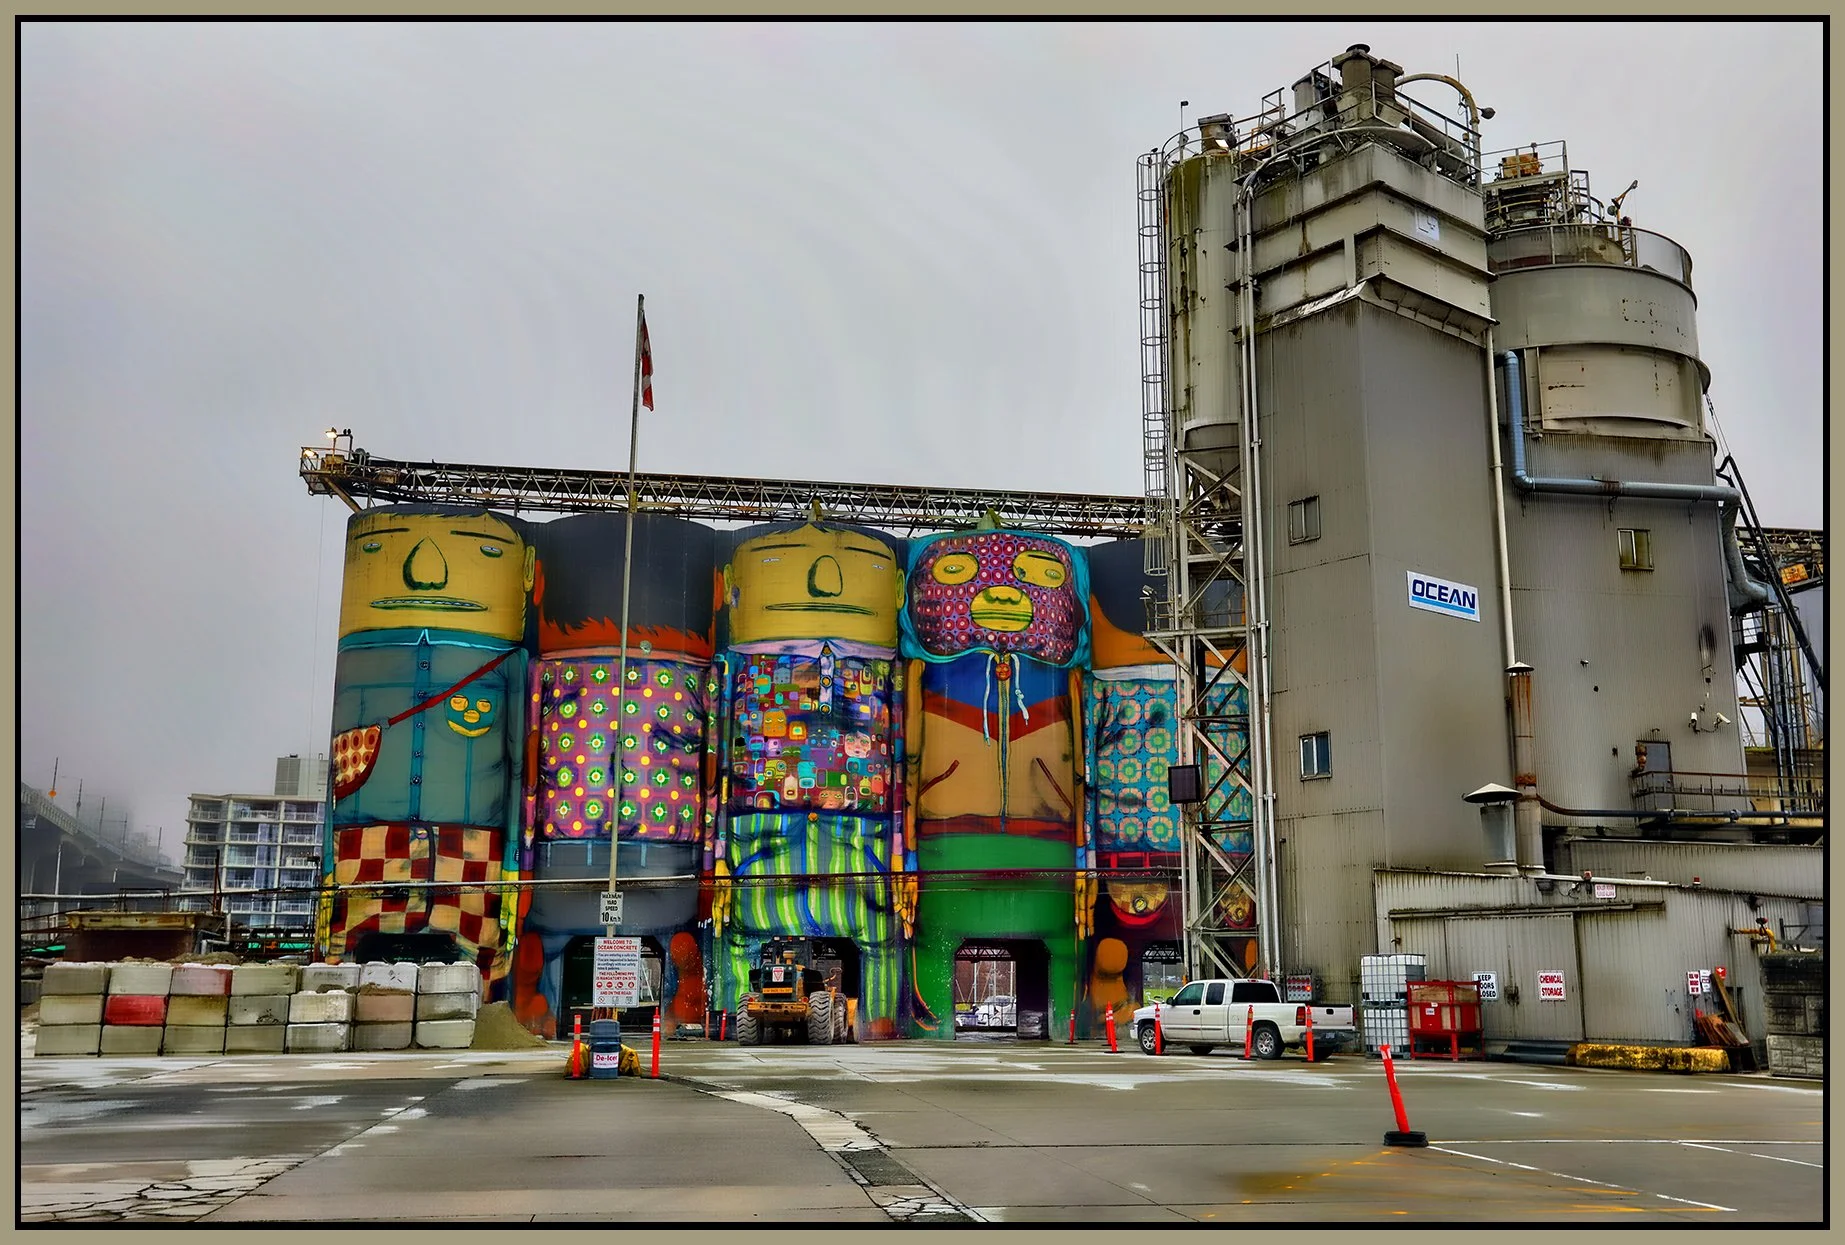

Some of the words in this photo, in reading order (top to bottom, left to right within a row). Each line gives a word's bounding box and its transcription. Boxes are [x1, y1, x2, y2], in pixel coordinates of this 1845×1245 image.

[1412, 579, 1475, 609] OCEAN
[602, 912, 610, 922] 10
[1540, 975, 1562, 984] CHEMICAL
[1542, 988, 1562, 996] STORAGE
